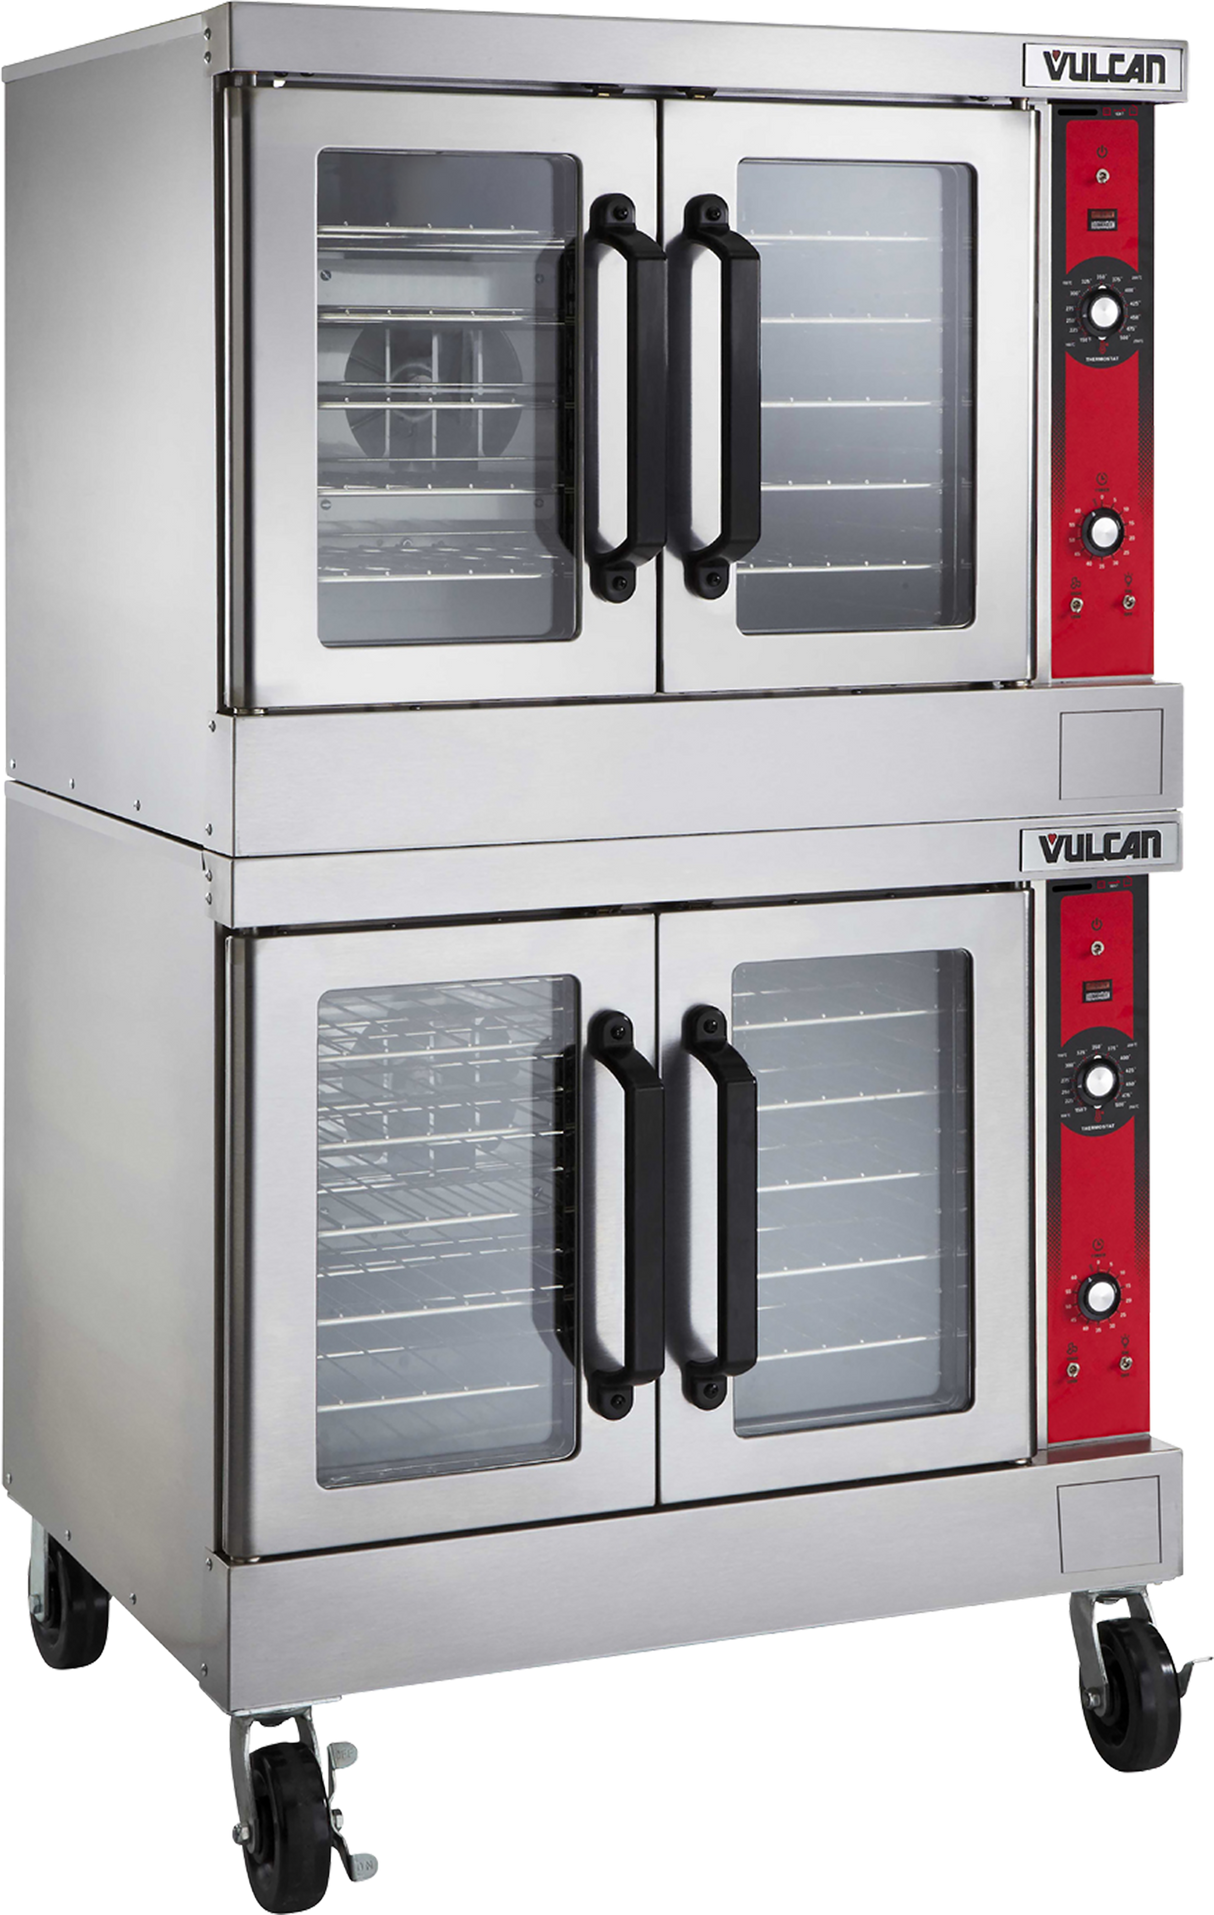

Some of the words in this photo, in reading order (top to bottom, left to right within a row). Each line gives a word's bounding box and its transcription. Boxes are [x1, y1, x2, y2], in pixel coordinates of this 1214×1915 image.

[1043, 50, 1166, 84] VULCAN
[1039, 831, 1161, 863] VULCAN
[1081, 1123, 1115, 1131] THERMOSTAT
[356, 1860, 374, 1871] ON
